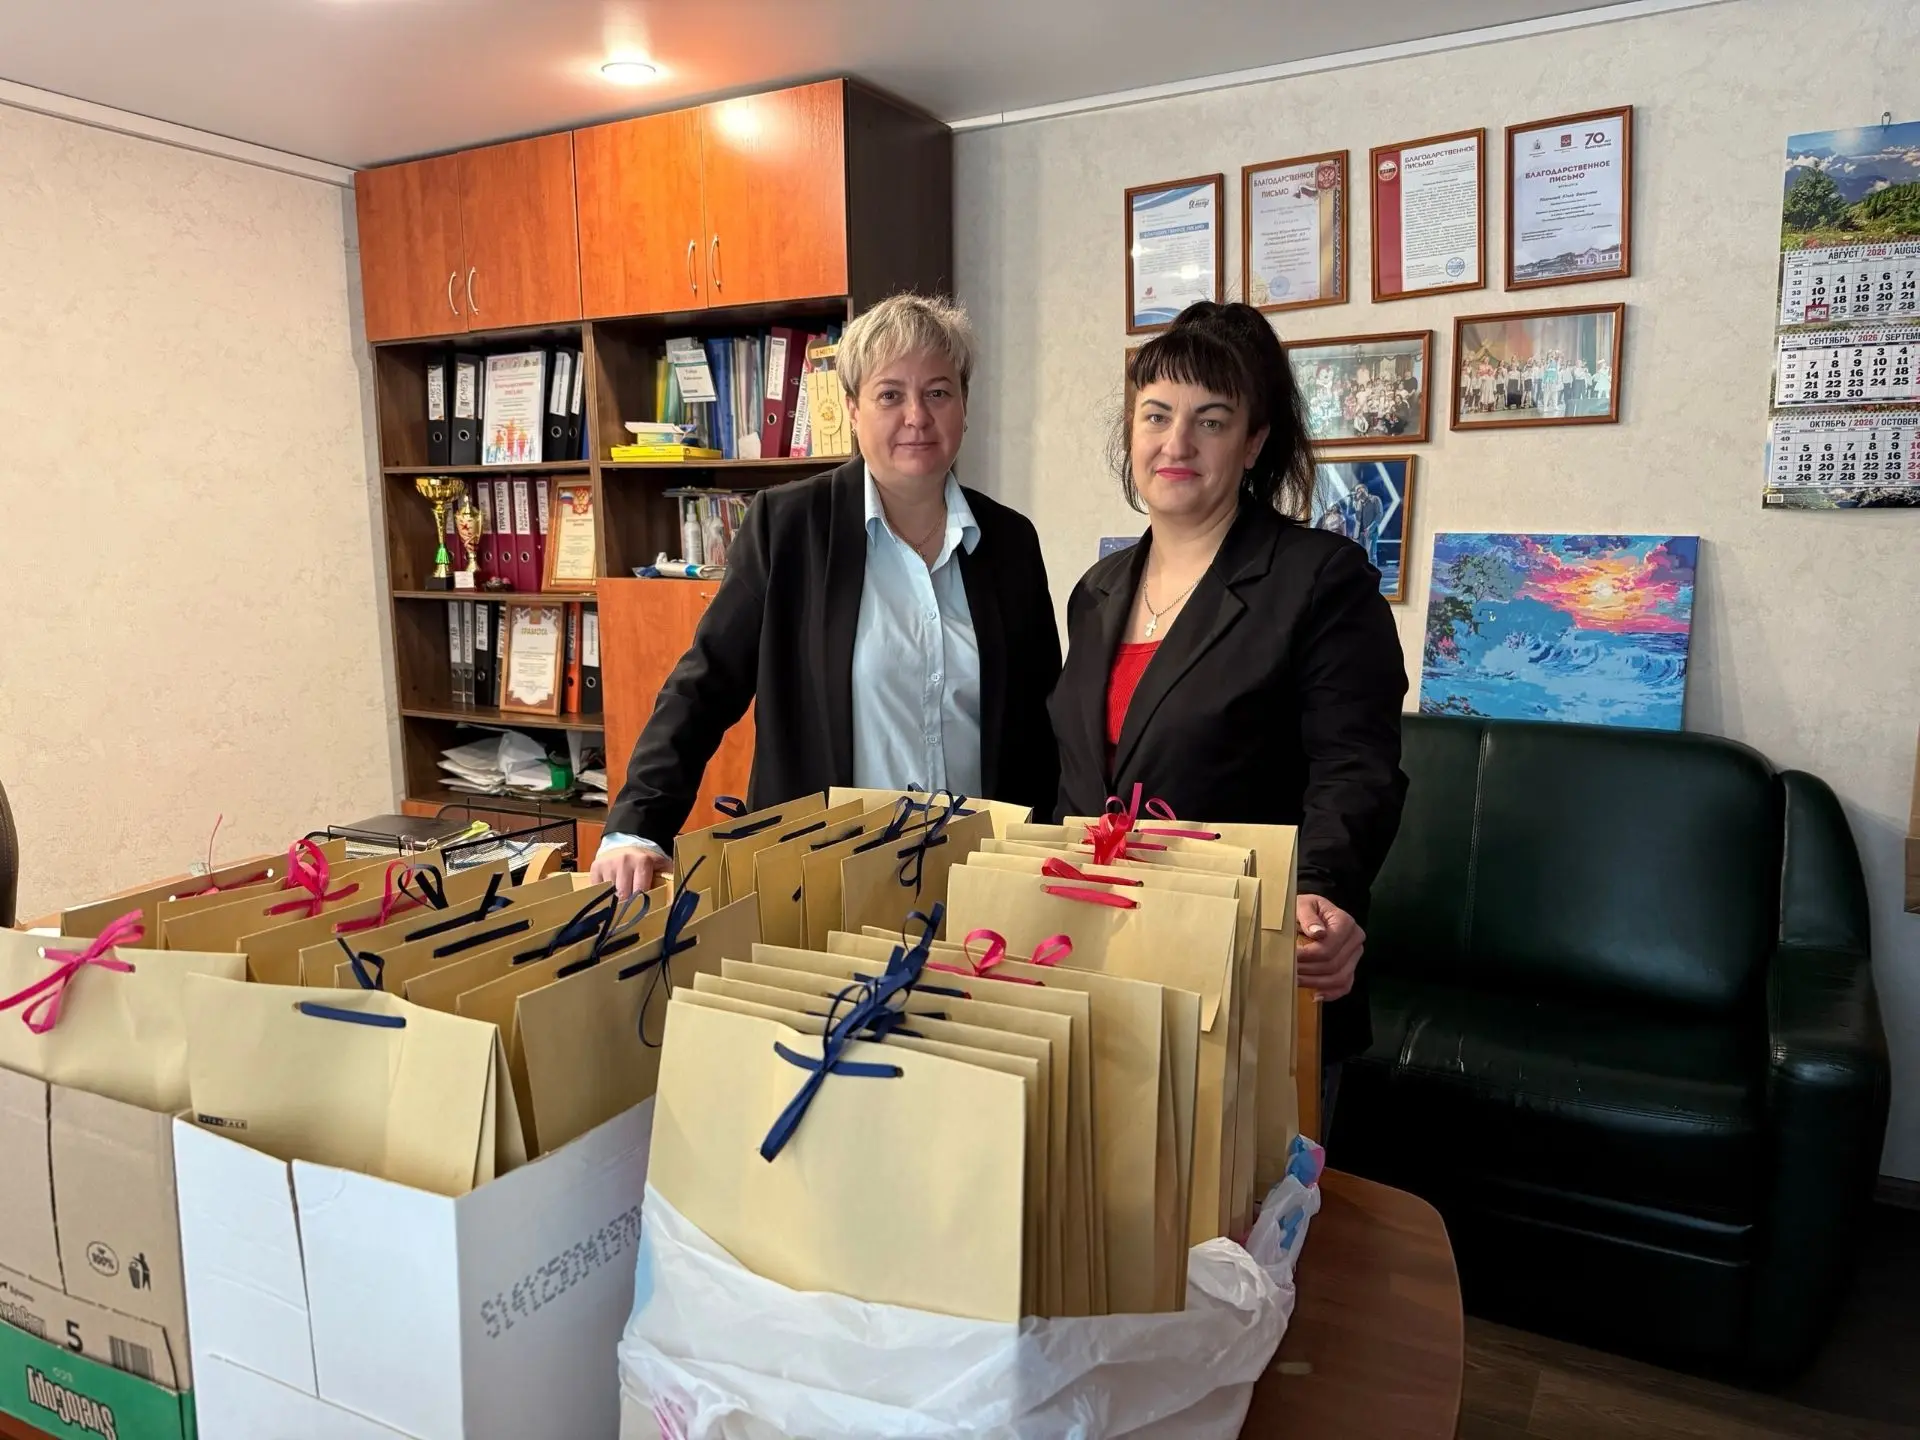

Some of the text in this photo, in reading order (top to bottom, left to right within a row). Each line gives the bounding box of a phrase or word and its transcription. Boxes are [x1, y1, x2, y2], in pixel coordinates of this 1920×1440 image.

[1585, 132, 1605, 146] 70
[1405, 145, 1475, 163] БЛАГОДАРСТВЕННОЕ
[1405, 159, 1434, 169] ПИСЬМО
[1525, 160, 1611, 179] БЛАГОДАРСТВЕННОЕ
[1253, 171, 1314, 188] БЛАГОДАРСТВЕННОЕ
[1549, 172, 1585, 184] ПИСЬМО
[1261, 187, 1289, 199] ПИСЬМО
[1828, 249, 1859, 259] АВГУСТ
[1866, 247, 1886, 256] 2026
[1815, 277, 1823, 285] 3
[1837, 275, 1845, 283] 4
[1860, 274, 1868, 282] 5
[1882, 272, 1890, 280] 6
[1906, 271, 1914, 279] 7
[1812, 287, 1825, 295] 10
[1835, 285, 1846, 293] 11
[1856, 284, 1870, 292] 12
[1879, 282, 1893, 291] 13
[1901, 281, 1915, 289] 14
[1812, 297, 1824, 305] 17
[1833, 295, 1847, 304] 18
[1856, 294, 1869, 302] 19
[1876, 292, 1893, 301] 20
[1900, 291, 1914, 299] 21
[1830, 305, 1847, 314] 25
[1853, 304, 1869, 313] 26
[1876, 303, 1892, 311] 27
[1898, 301, 1915, 310] 28
[1809, 336, 1850, 345] СЕНТЯБРЬ
[1858, 334, 1878, 342] 2026
[1833, 350, 1838, 358] 1
[1854, 349, 1862, 357] 2
[1877, 348, 1885, 356] 3
[1810, 361, 1817, 369] 7
[1831, 360, 1839, 368] 8
[1854, 359, 1861, 367] 9
[1873, 358, 1887, 366] 10
[1897, 357, 1908, 365] 11
[1806, 371, 1819, 379] 14
[1828, 370, 1841, 378] 15
[1850, 369, 1863, 377] 16
[1873, 368, 1886, 376] 17
[1895, 367, 1909, 375] 18
[1804, 381, 1818, 389] 21
[1825, 380, 1841, 388] 22
[1848, 379, 1864, 387] 23
[1870, 378, 1886, 386] 24
[1893, 377, 1909, 385] 25
[1803, 391, 1818, 399] 28
[1825, 390, 1841, 398] 29
[1847, 389, 1863, 397] 30
[1810, 420, 1846, 428] ОКТЯБРЬ
[1881, 418, 1918, 426] OCTOBER
[1871, 432, 1876, 440] 1
[1892, 432, 1900, 440] 2
[1802, 444, 1810, 452] 5
[1847, 443, 1854, 451] 7
[1869, 442, 1876, 450] 8
[1891, 442, 1899, 450] 9
[1821, 453, 1834, 461] 13
[1843, 453, 1856, 461] 14
[1865, 452, 1878, 460] 15
[1888, 452, 1901, 460] 16
[1798, 463, 1811, 471] 19
[1818, 463, 1834, 471] 20
[1863, 462, 1879, 470] 22
[1885, 462, 1901, 470] 23
[1796, 473, 1811, 481] 26
[1818, 473, 1833, 481] 27
[1839, 472, 1855, 480] 28
[1862, 472, 1878, 480] 29
[1884, 472, 1901, 480] 30
[66, 1319, 83, 1353] 5
[26, 1364, 118, 1440] SvetoCopy
